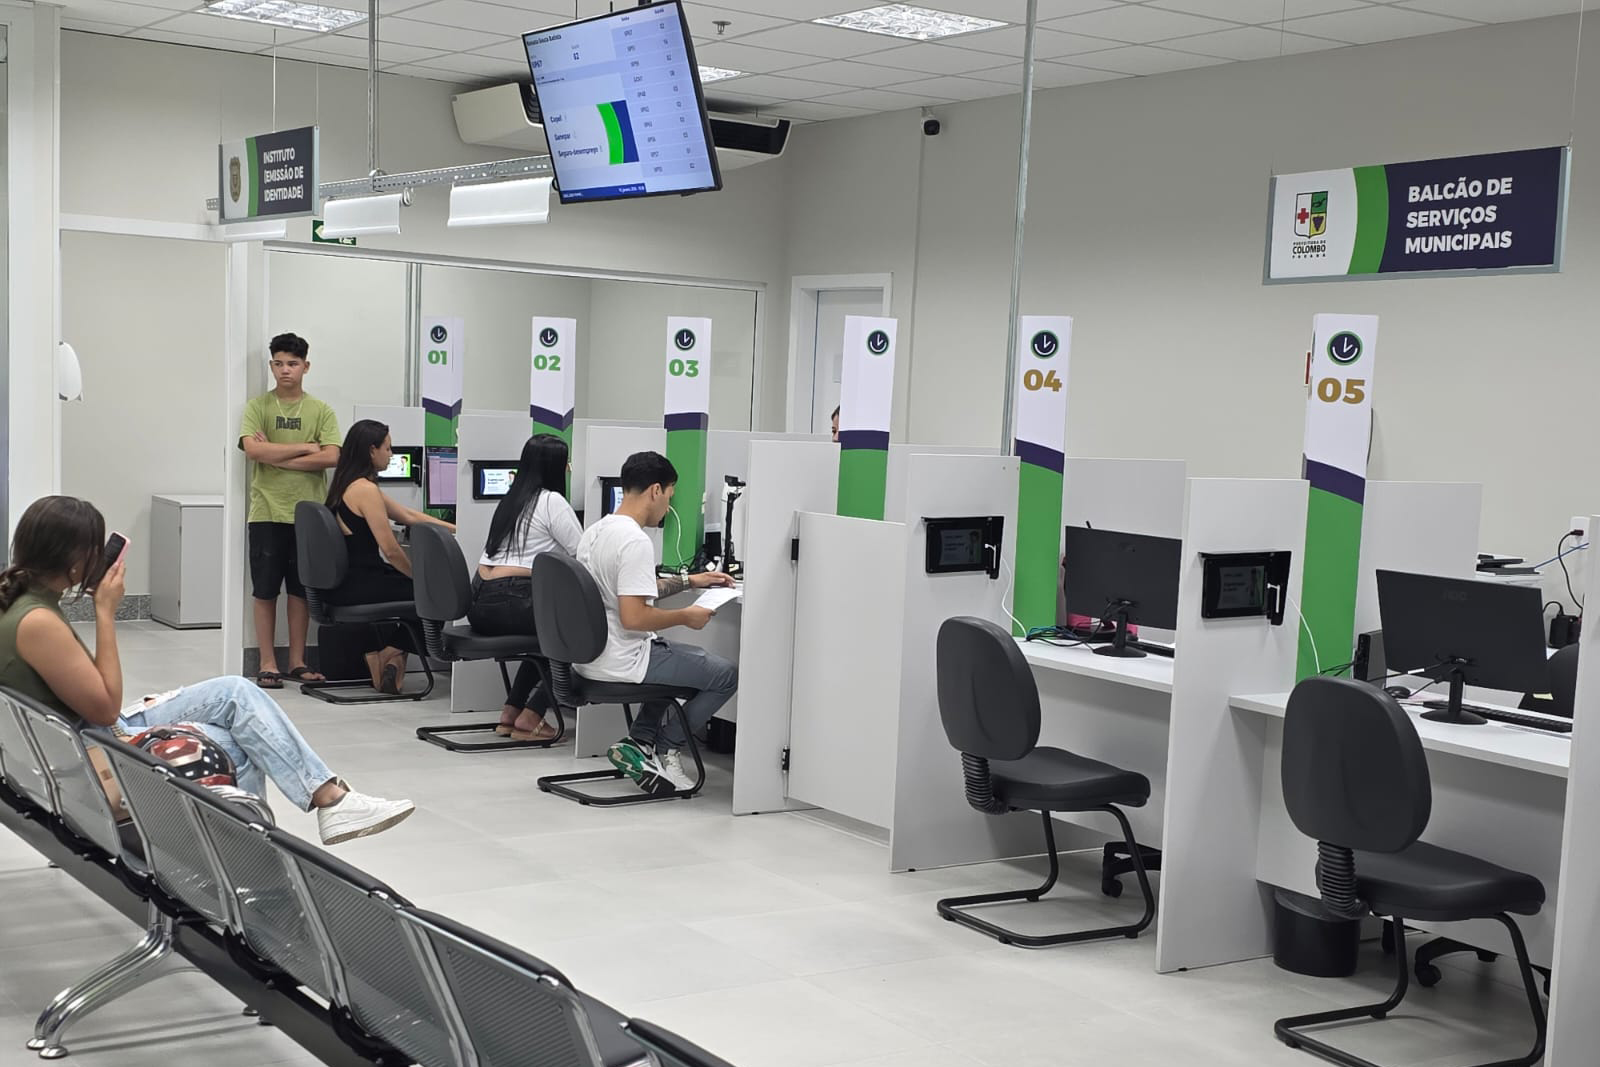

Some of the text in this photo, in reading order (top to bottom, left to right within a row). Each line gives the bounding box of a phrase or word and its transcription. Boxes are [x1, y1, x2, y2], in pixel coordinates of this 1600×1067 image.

[263, 147, 295, 164] INSTITUTO
[264, 165, 304, 184] (EMISSÃO DE
[264, 184, 304, 202] IDENTIDADE)
[1408, 176, 1513, 203] BALCÃO DE
[1406, 205, 1498, 230] SERVIÇOS
[1292, 244, 1326, 255] COLOMBO
[1404, 230, 1513, 254] MUNICIPAIS
[427, 350, 448, 365] 01
[533, 354, 561, 371] 02
[668, 359, 699, 377] 03
[1023, 368, 1063, 392] 04
[1317, 377, 1366, 404] 05
